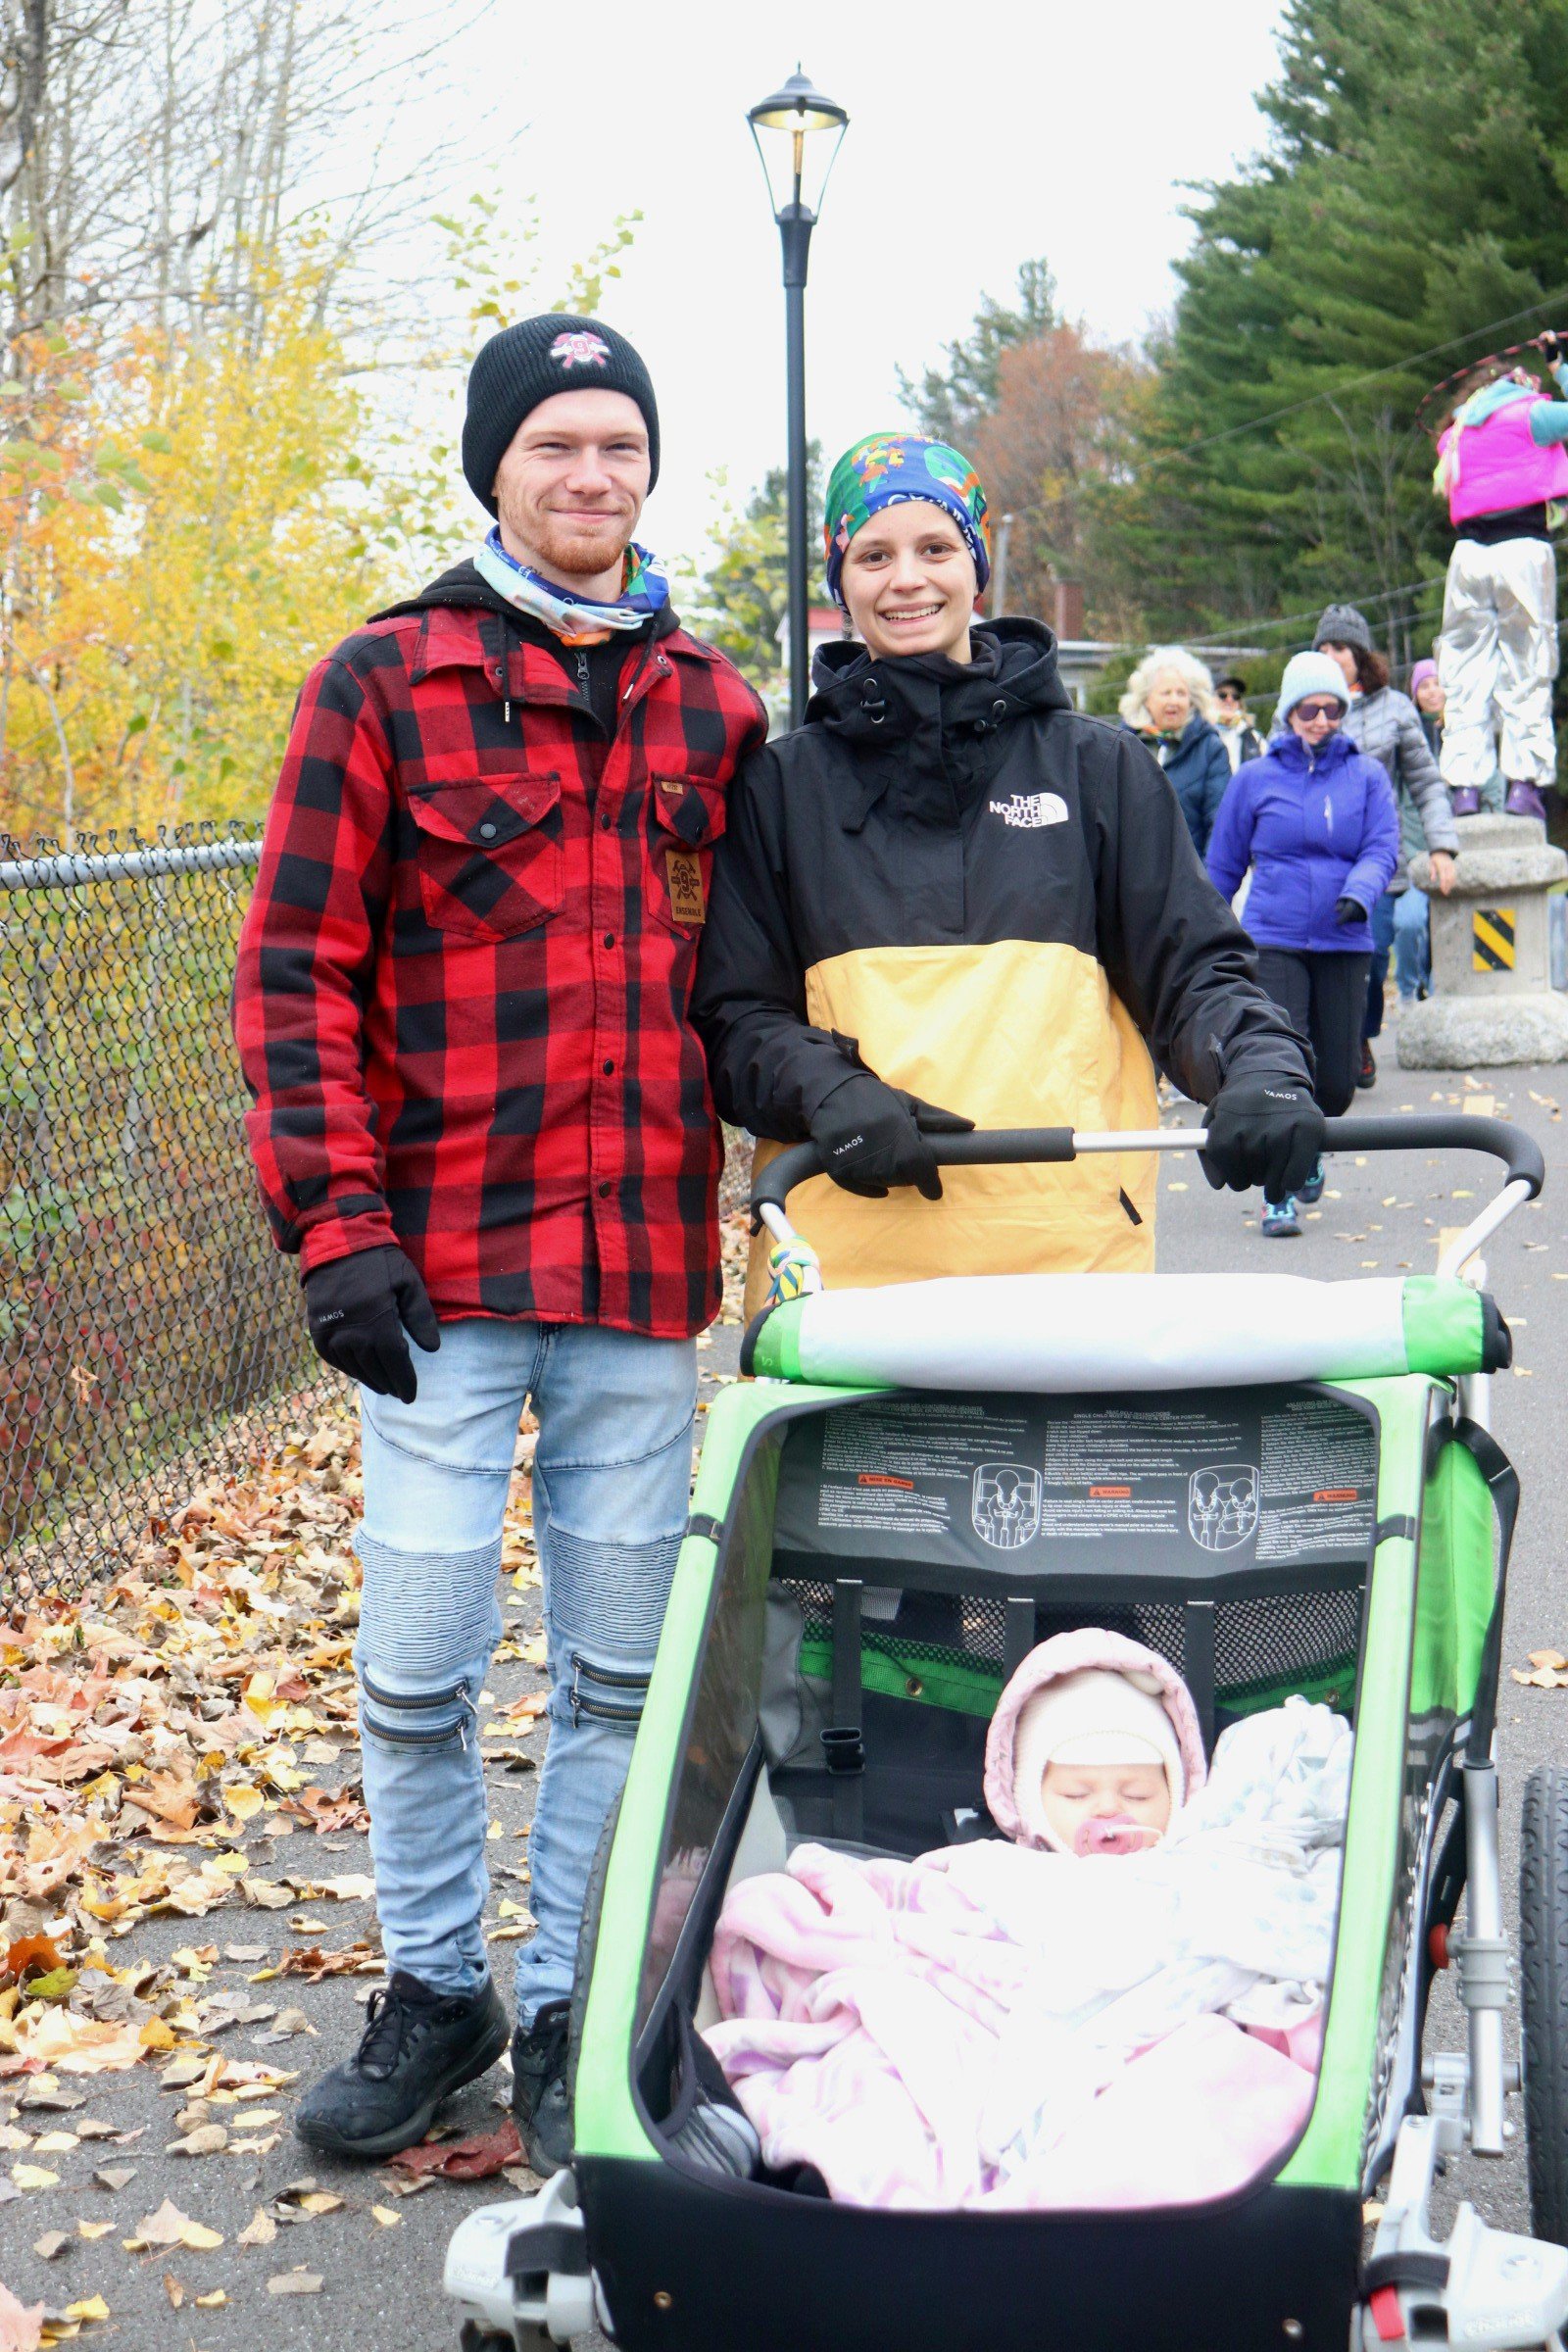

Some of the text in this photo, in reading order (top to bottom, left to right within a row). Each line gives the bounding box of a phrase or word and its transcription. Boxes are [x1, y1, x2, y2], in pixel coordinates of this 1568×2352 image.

[1010, 794, 1040, 807] THE
[989, 801, 1041, 817] NORTH
[1004, 814, 1042, 828] FACE
[1264, 1089, 1298, 1101] VAMOS
[833, 1135, 863, 1155] VAMOS
[318, 1309, 345, 1323] VAMOS
